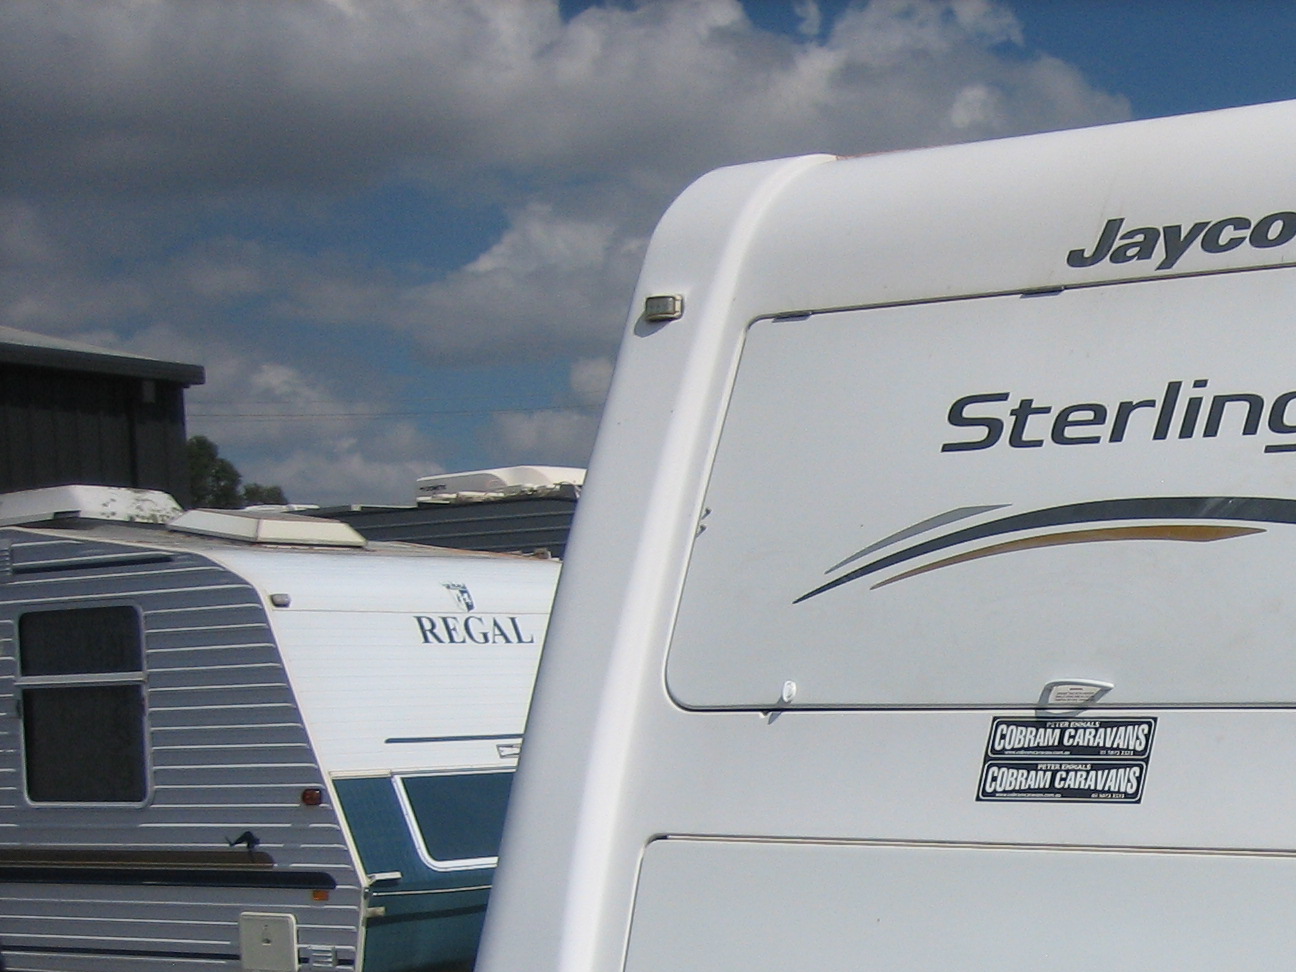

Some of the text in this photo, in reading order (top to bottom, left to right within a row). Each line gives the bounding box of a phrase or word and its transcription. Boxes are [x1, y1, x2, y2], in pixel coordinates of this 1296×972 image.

[413, 615, 535, 644] REGAL
[994, 723, 1149, 751] COBRAM CARAVANS
[985, 766, 1140, 794] COBRAM CARAVANS
